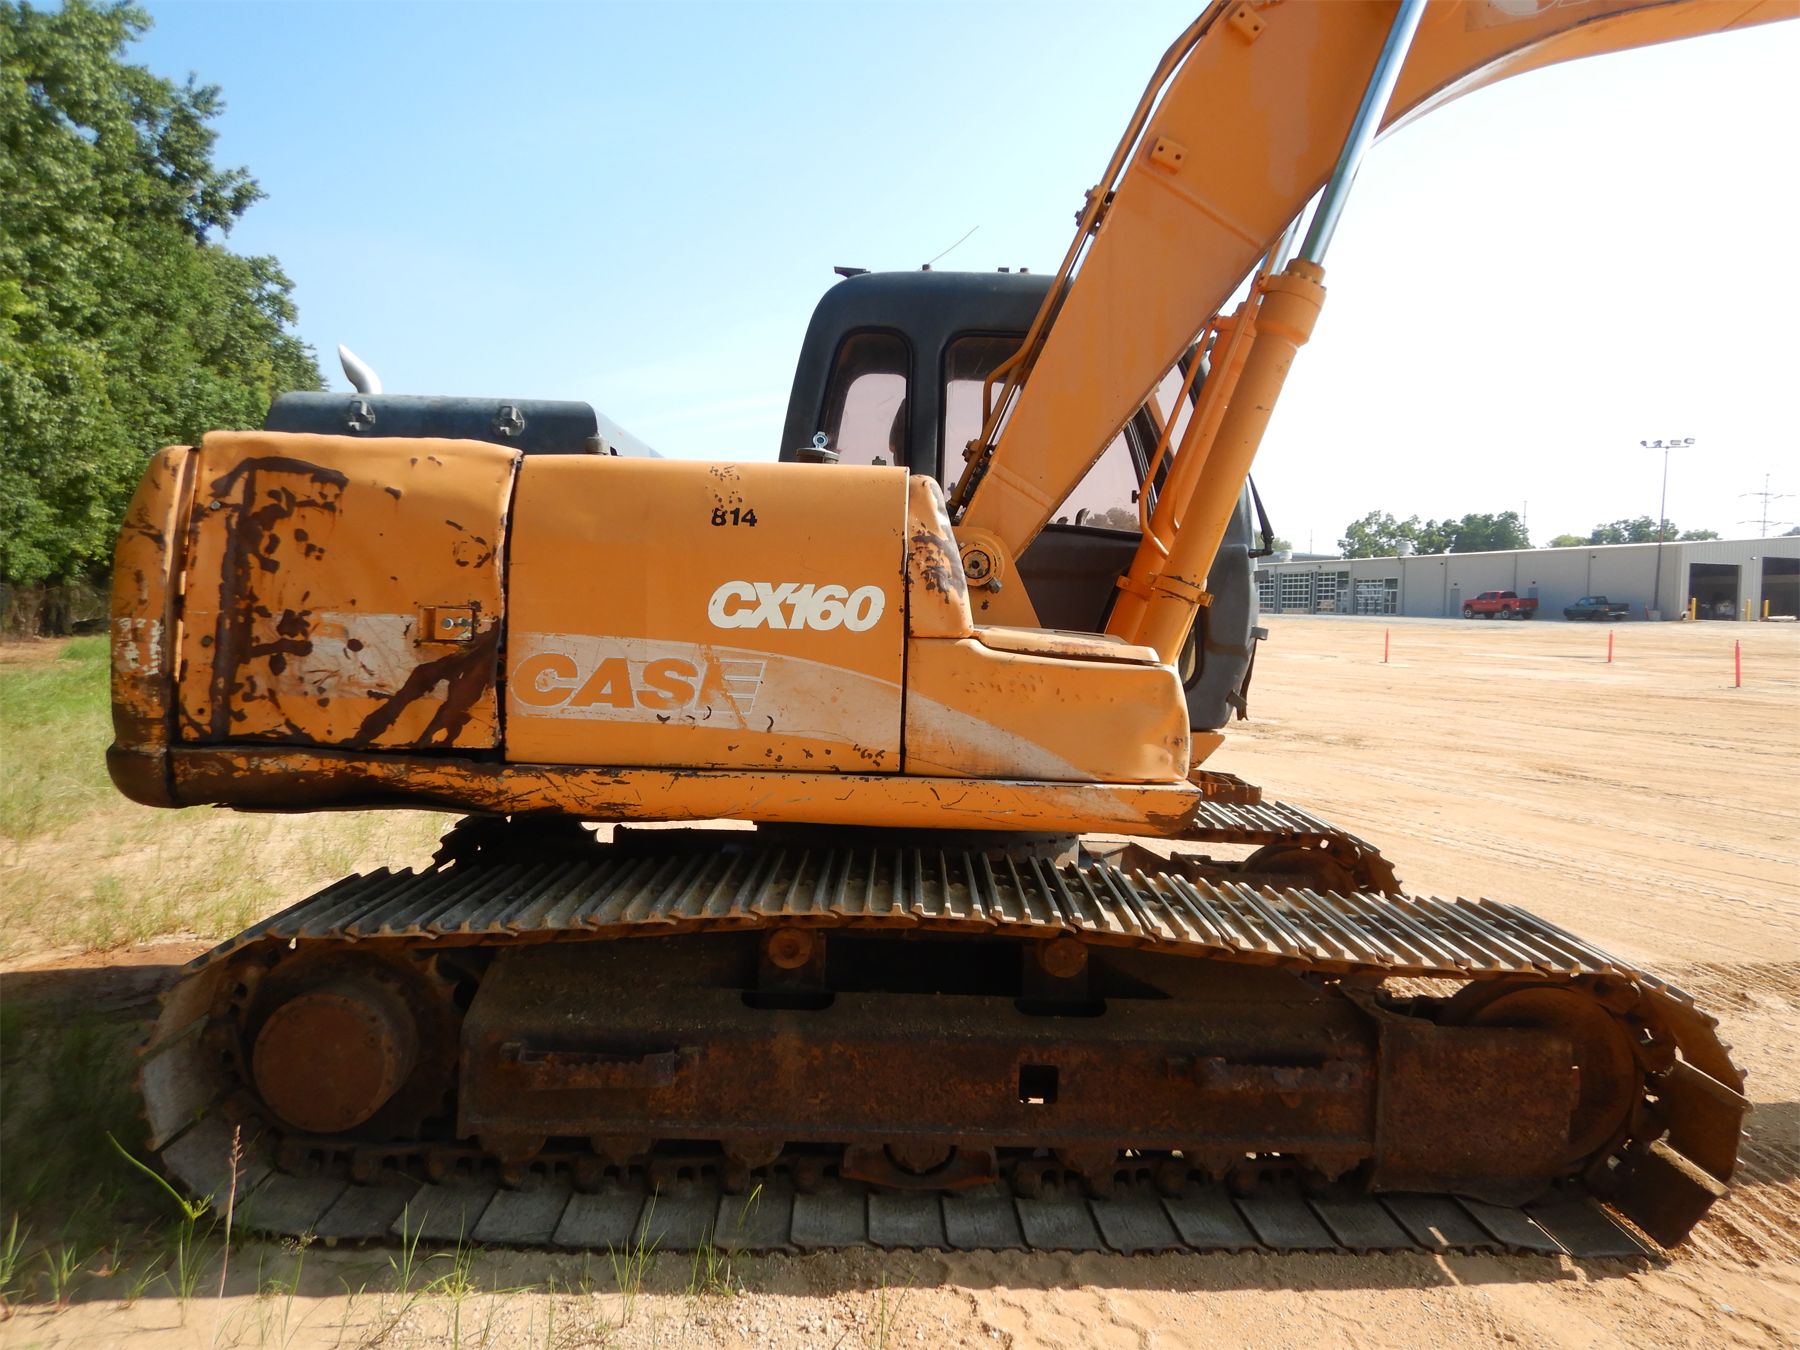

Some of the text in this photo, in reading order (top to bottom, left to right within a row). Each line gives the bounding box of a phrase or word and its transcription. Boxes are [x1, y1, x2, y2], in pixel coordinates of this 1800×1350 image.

[711, 507, 758, 527] 814
[708, 580, 886, 632] CX160
[511, 652, 767, 714] CASE
